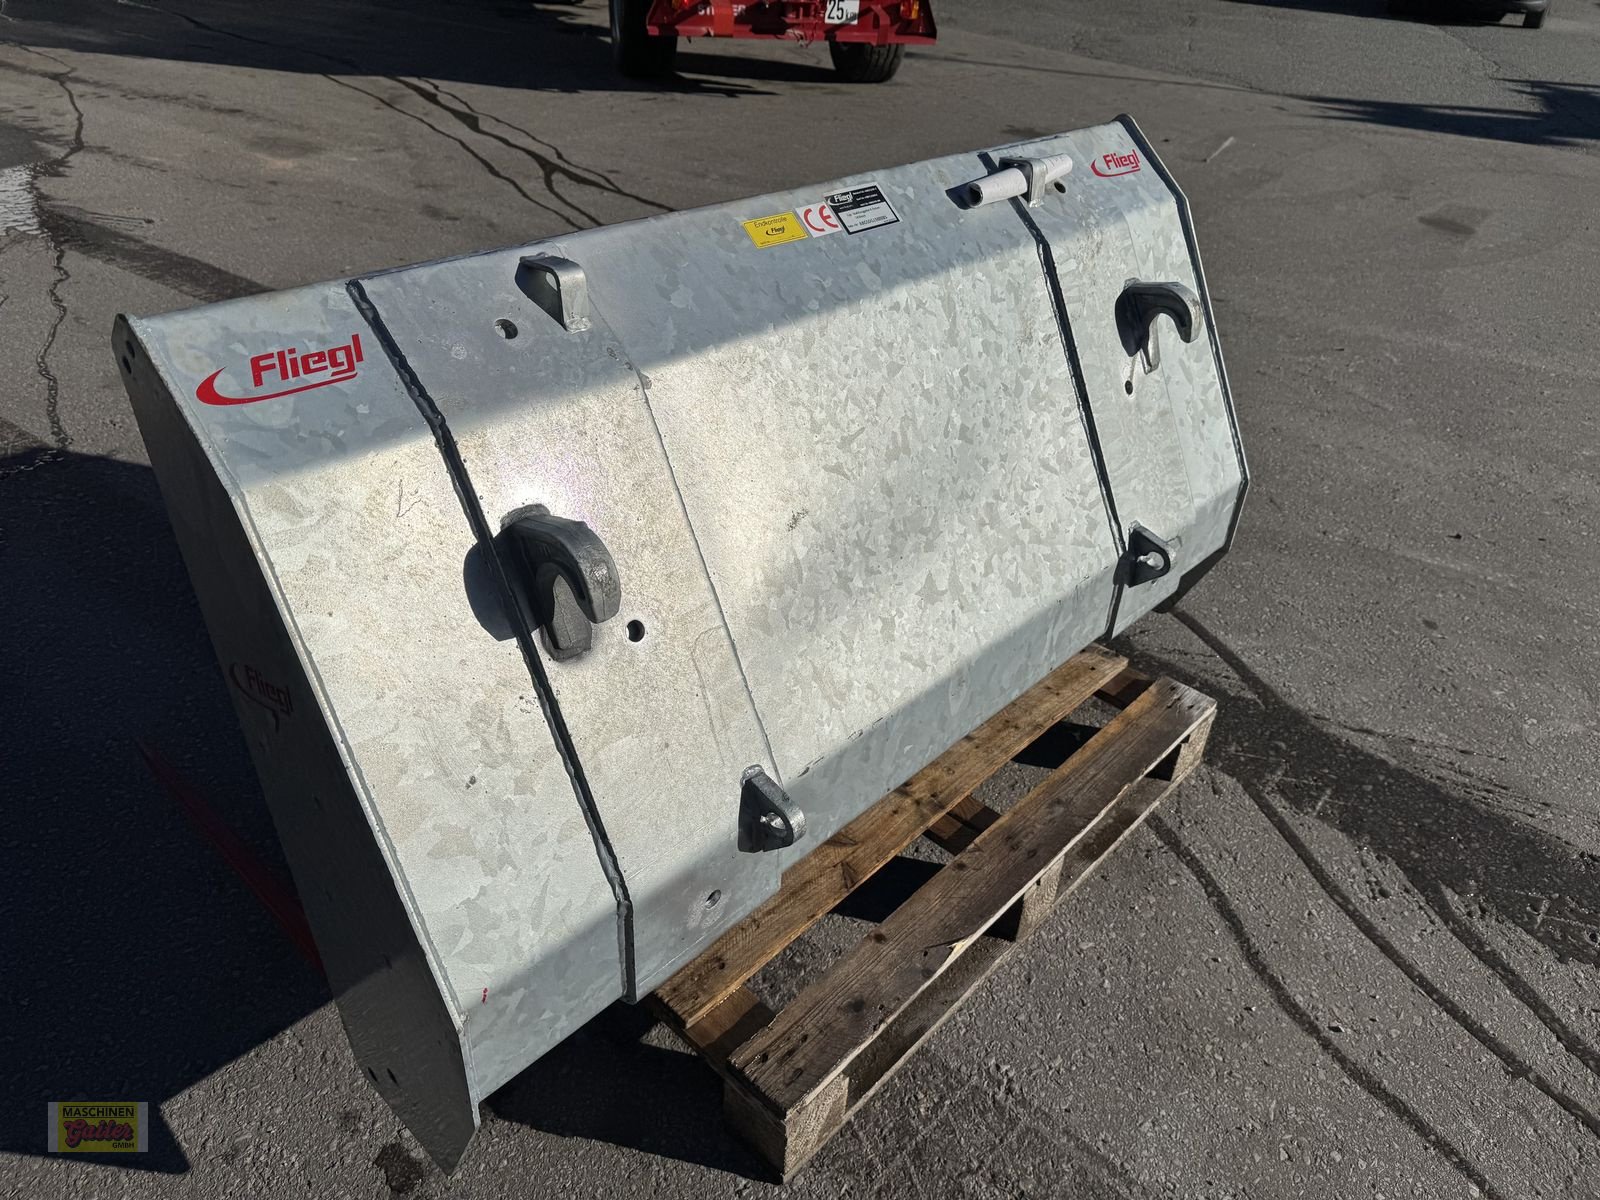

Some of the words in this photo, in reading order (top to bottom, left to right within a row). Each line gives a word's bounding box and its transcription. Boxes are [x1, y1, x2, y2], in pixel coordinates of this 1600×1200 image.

[827, 0, 844, 20] 25
[1103, 149, 1140, 170] Fliegl
[833, 191, 853, 203] Fliegl
[753, 217, 787, 229] Endkontrolle
[804, 204, 839, 232] CE
[250, 333, 364, 387] Fliegl
[244, 663, 294, 717] Fliegl
